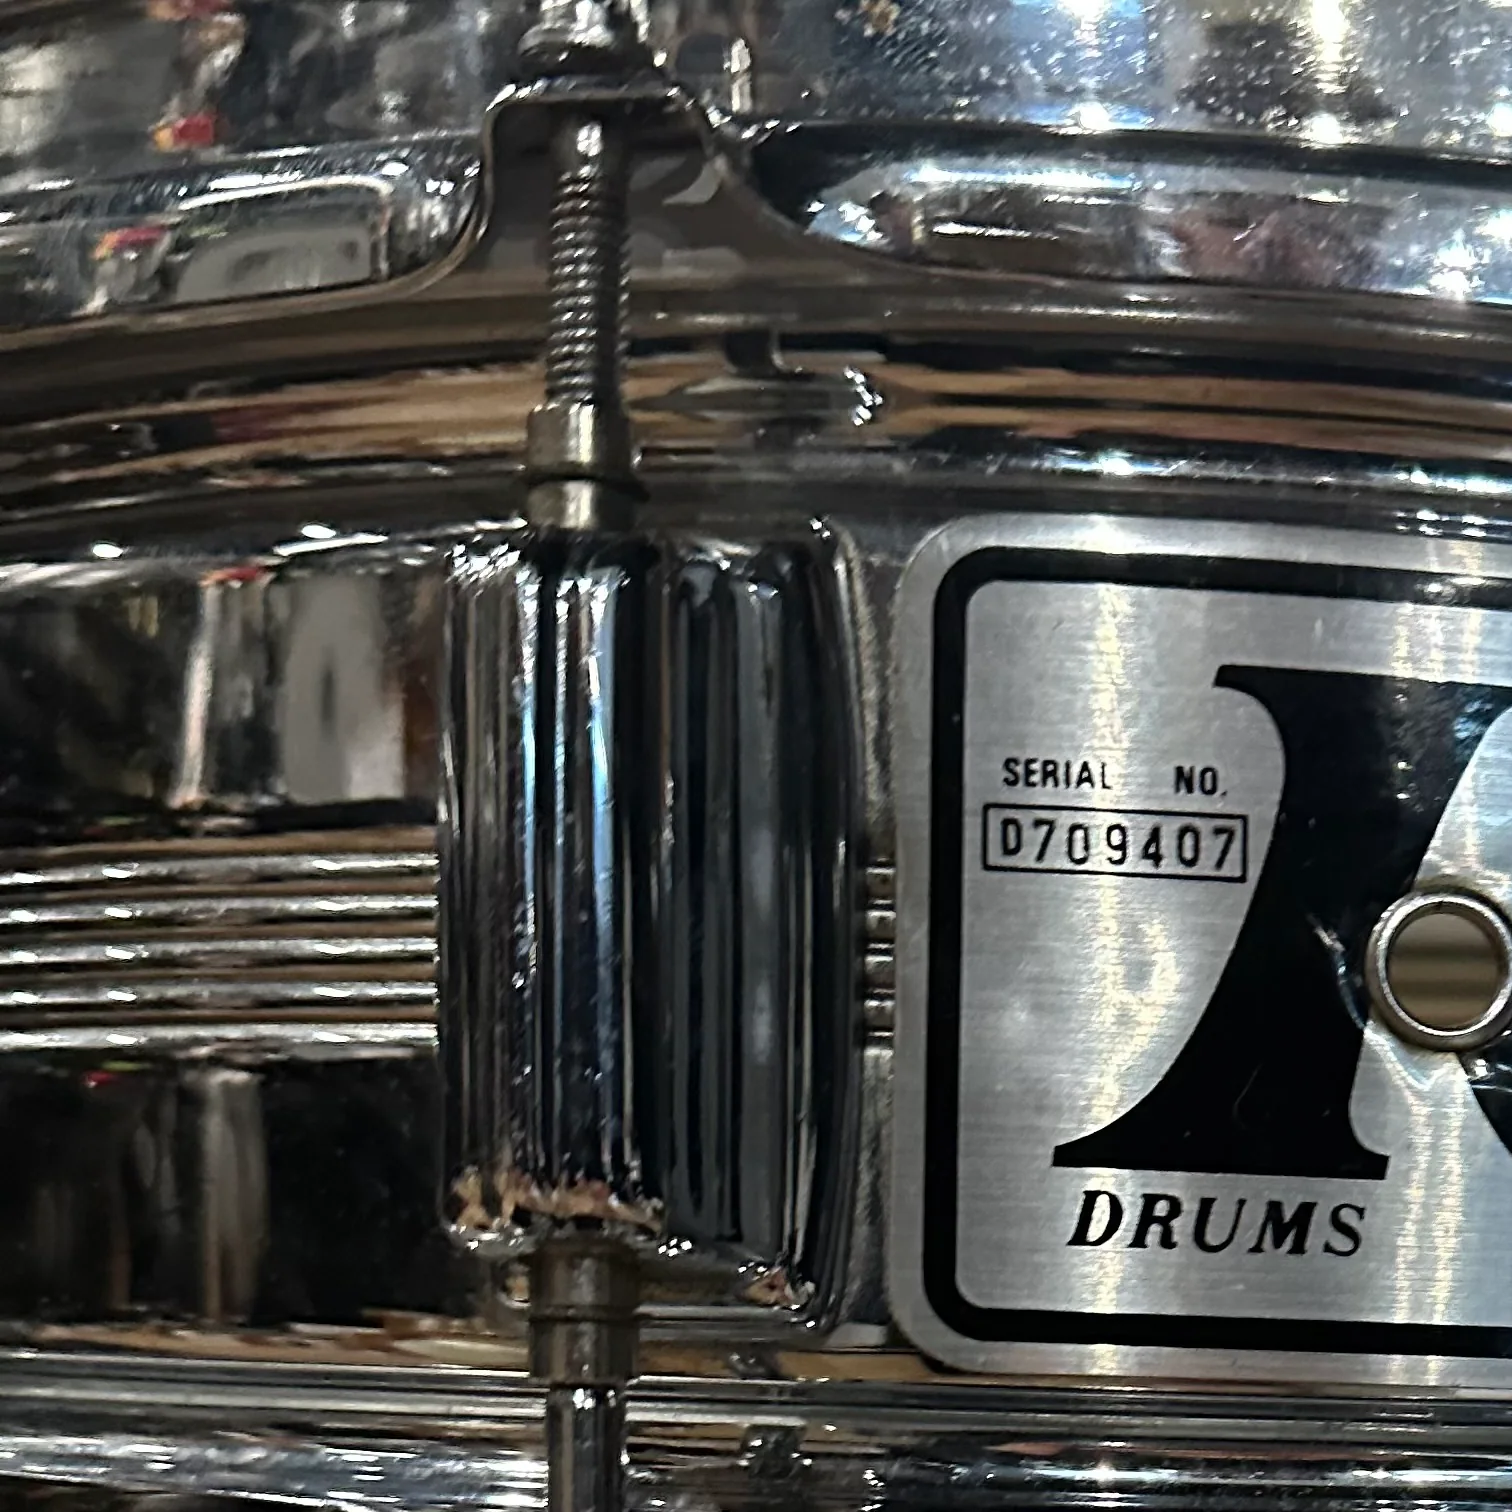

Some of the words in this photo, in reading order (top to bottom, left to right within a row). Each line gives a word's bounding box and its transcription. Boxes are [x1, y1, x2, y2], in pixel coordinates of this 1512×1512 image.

[1003, 757, 1113, 790] SERIAL
[1174, 765, 1228, 798] NO.
[1000, 818, 1236, 861] D709407
[1066, 1190, 1366, 1257] DRUMS
